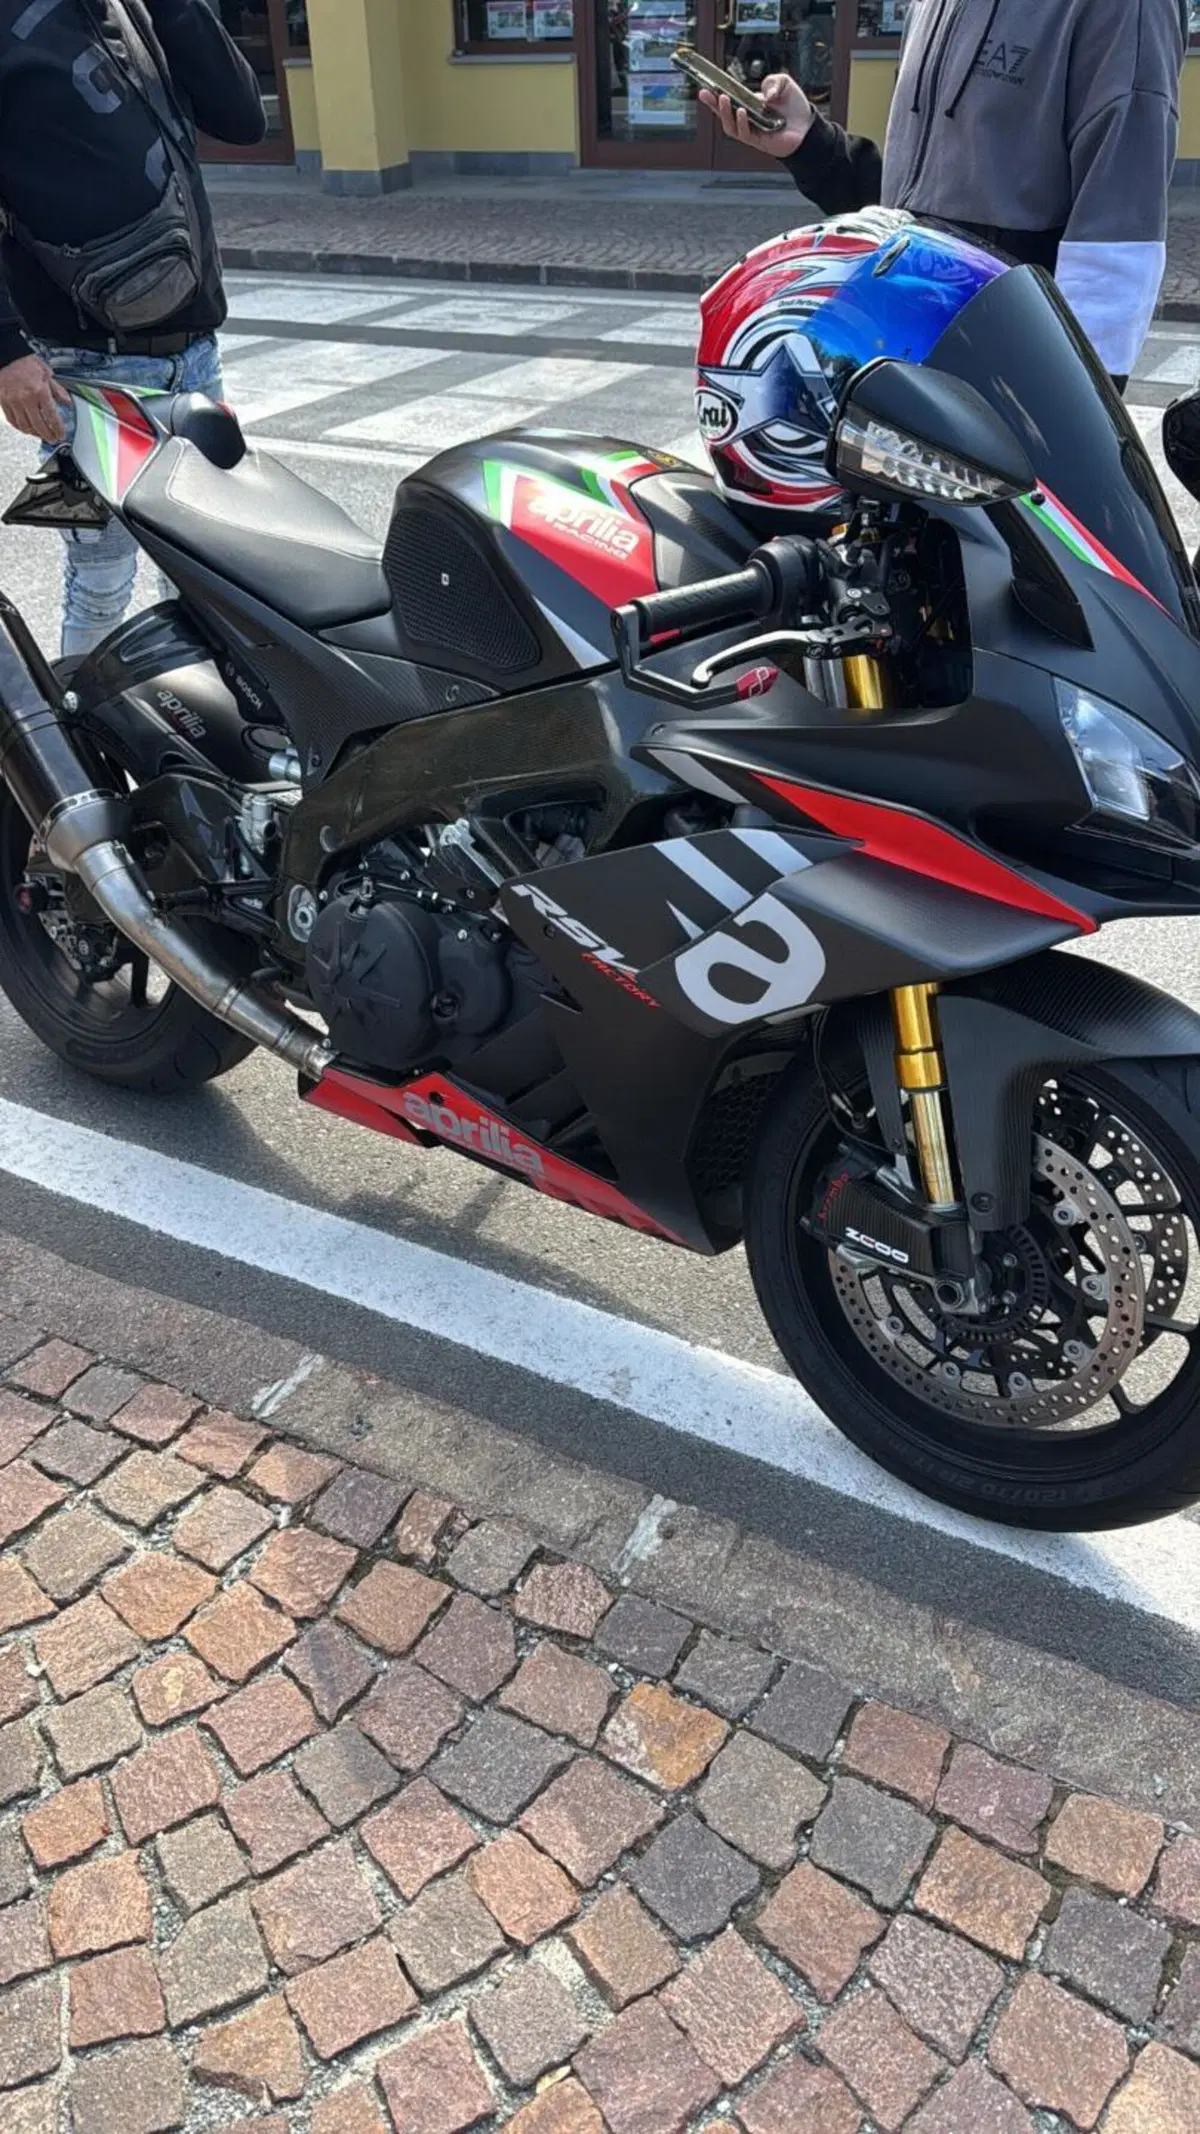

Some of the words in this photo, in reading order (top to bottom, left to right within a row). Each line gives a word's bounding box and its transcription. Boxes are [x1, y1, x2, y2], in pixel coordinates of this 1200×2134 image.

[528, 492, 640, 553] aprilia
[157, 690, 207, 739] aprilia
[581, 952, 661, 1009] FACTORY
[402, 1091, 546, 1178] aprilia
